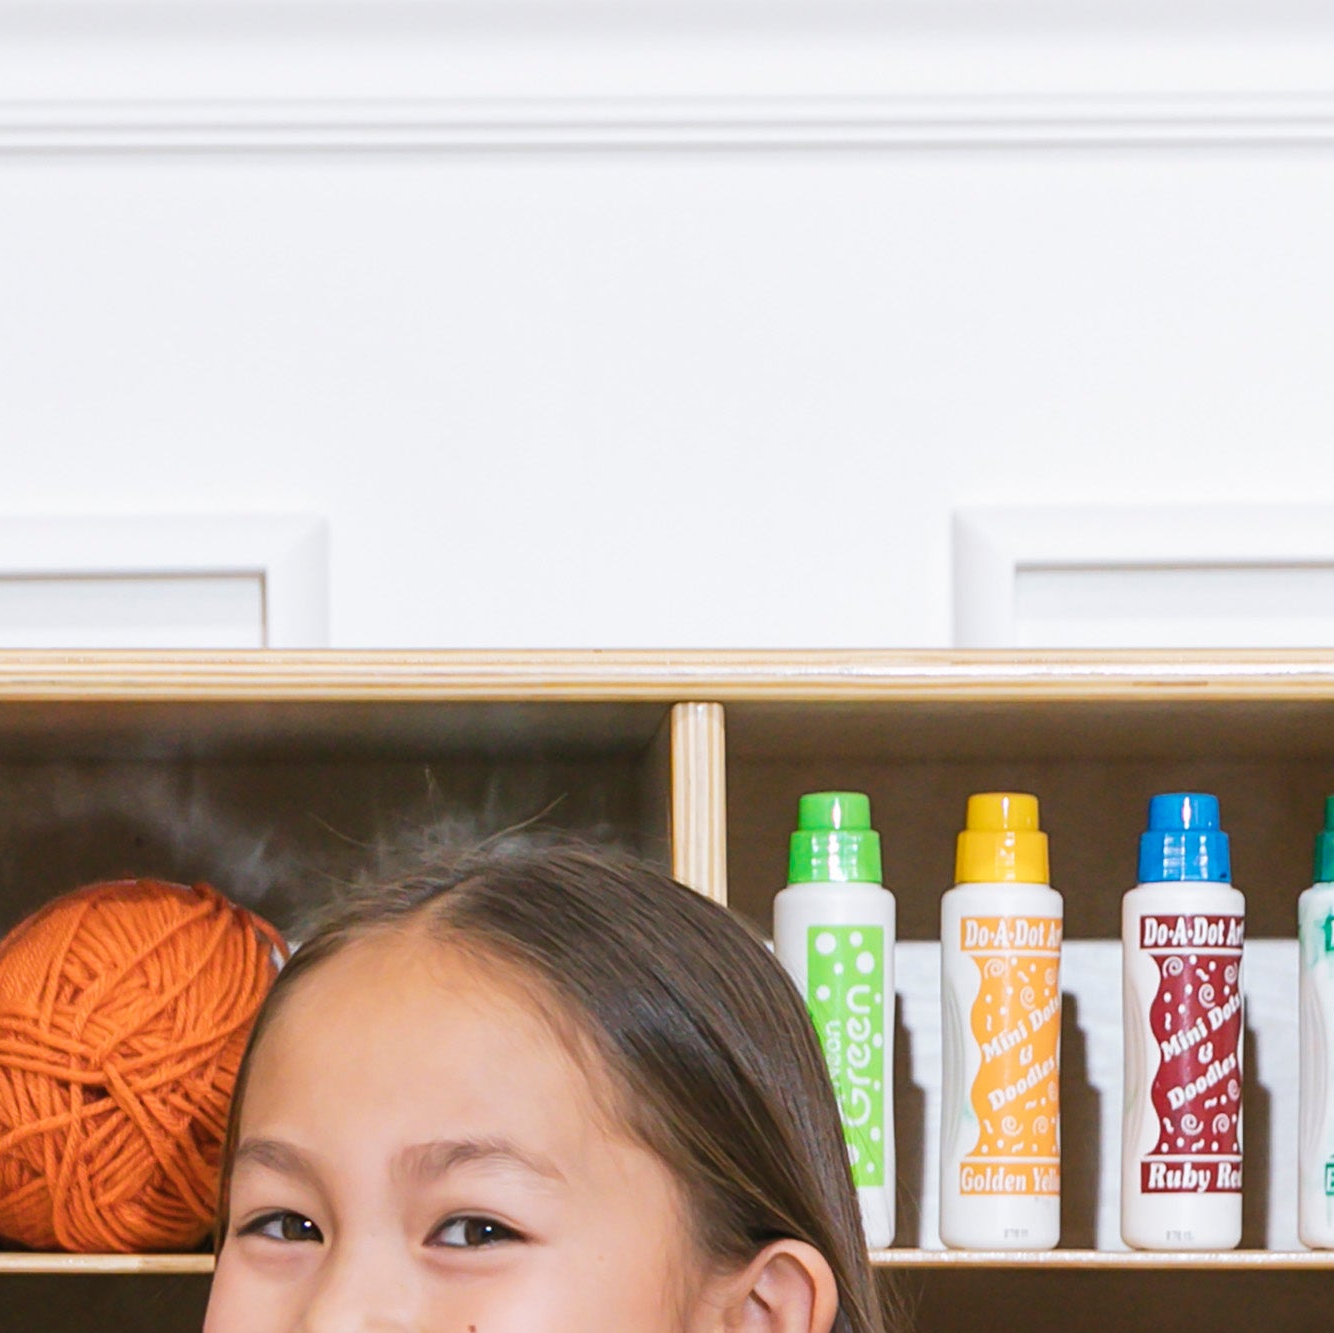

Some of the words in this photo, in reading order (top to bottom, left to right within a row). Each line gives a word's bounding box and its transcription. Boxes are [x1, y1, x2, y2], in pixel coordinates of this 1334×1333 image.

[981, 1021, 1027, 1063] Mini
[1160, 1018, 1208, 1062] Mini
[1208, 993, 1241, 1032] Dots
[837, 984, 871, 1127] Green
[1198, 1041, 1213, 1064] &
[988, 1055, 1055, 1111] Doodles
[1167, 1052, 1237, 1111] Doodles
[961, 1166, 1027, 1193] Golden
[1147, 1164, 1211, 1193] Ruby
